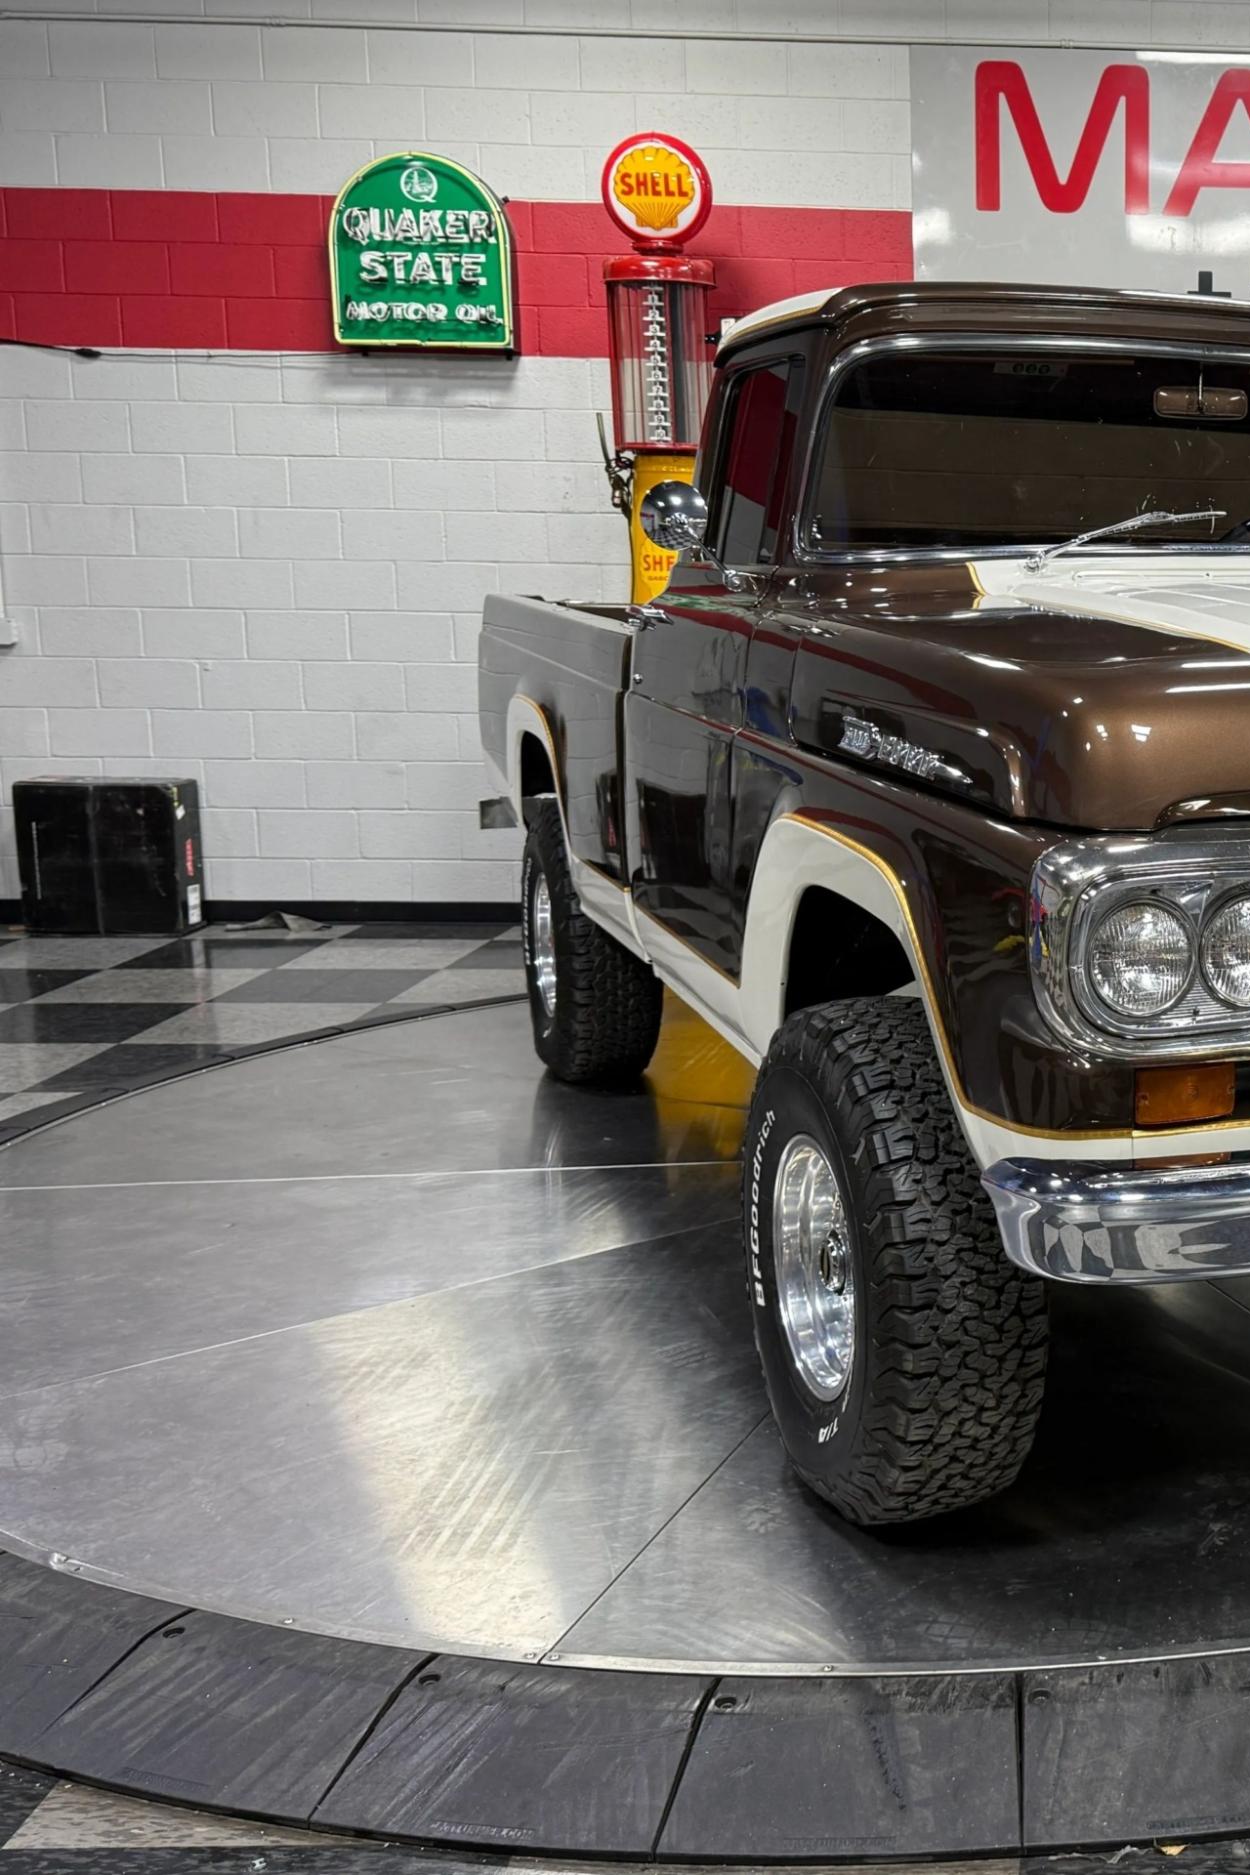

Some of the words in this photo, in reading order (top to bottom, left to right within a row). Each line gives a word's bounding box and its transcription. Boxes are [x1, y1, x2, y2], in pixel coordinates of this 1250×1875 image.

[620, 172, 689, 198] SHELL
[343, 207, 497, 246] QUAKER
[359, 251, 488, 286] STATE
[346, 301, 448, 322] MOTOR
[746, 1109, 775, 1307] BFGoodrich
